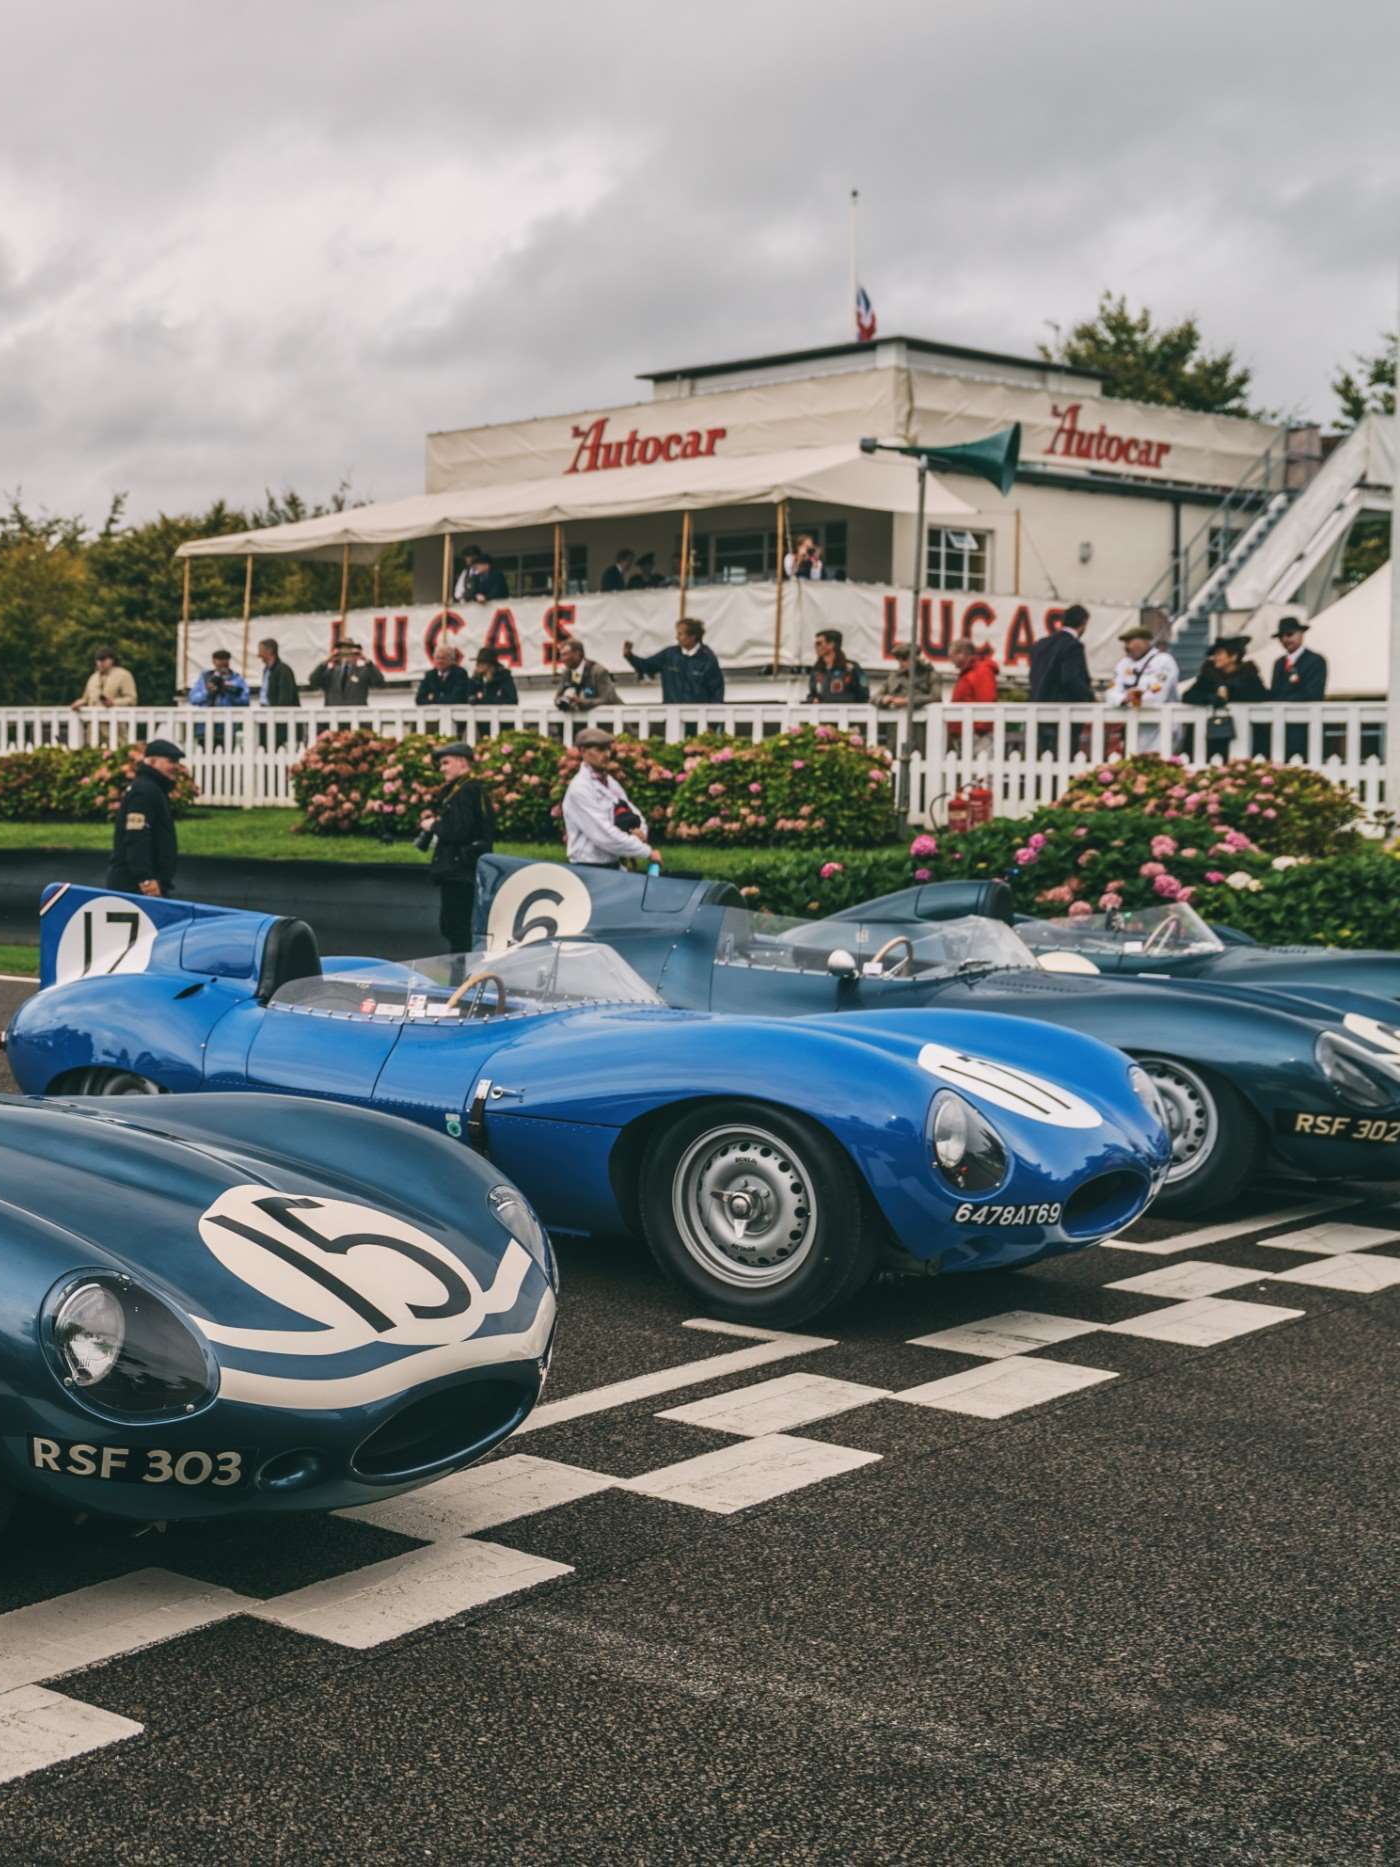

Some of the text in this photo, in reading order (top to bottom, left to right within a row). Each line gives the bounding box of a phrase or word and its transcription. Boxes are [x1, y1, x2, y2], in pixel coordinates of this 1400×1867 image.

[562, 416, 727, 475] Autocar
[1043, 402, 1172, 469] Autocar
[81, 911, 139, 977] 17
[512, 888, 565, 943] 6
[1295, 1113, 1400, 1142] RSF 302
[954, 1202, 1061, 1226] 6478AT69
[202, 1196, 472, 1334] 15
[32, 1436, 242, 1487] RSF 303
